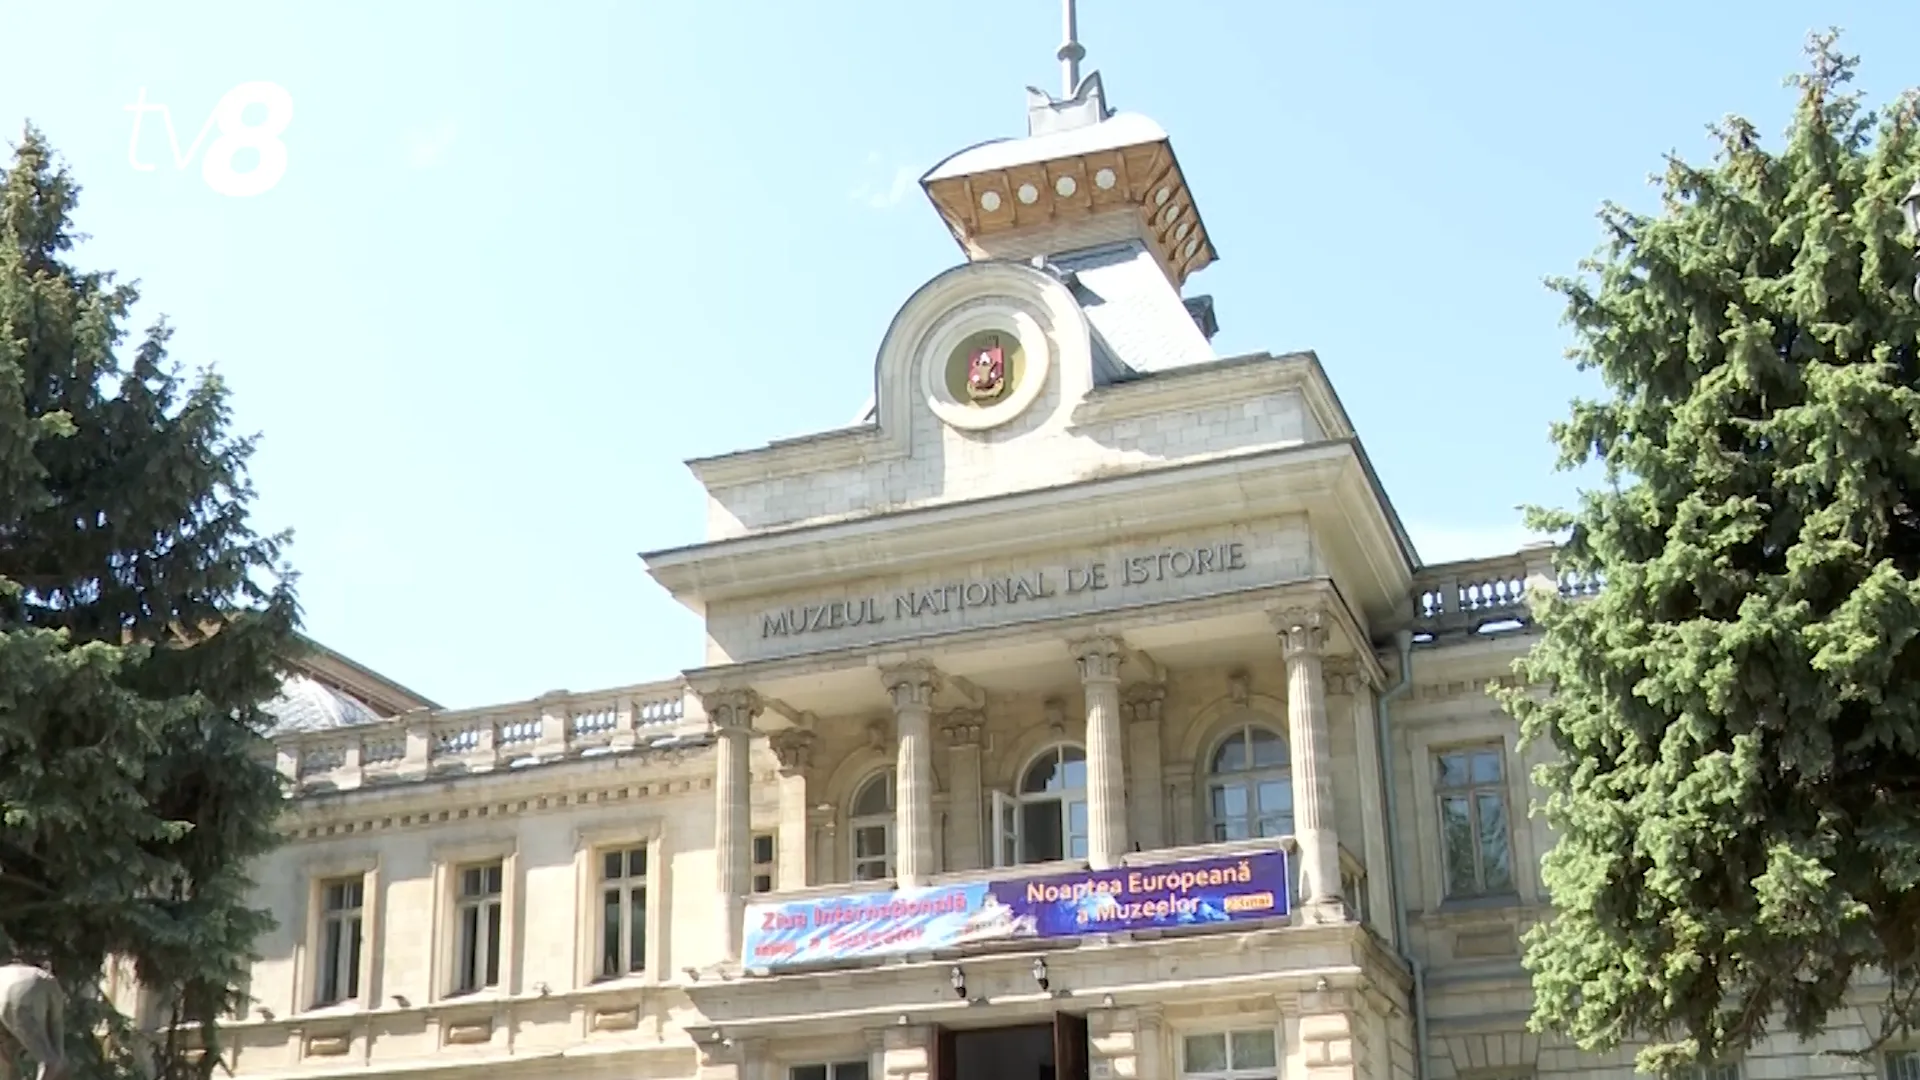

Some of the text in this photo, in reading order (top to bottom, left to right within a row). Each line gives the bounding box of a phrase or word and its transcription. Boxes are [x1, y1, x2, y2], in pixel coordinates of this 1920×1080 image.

[761, 600, 885, 640] MUZEUL
[1069, 563, 1109, 594] DE
[1121, 543, 1246, 587] ISTORIE
[1026, 860, 1252, 905] Noaptea Europeană
[1076, 908, 1088, 925] a
[1096, 895, 1200, 922] Muzeelor
